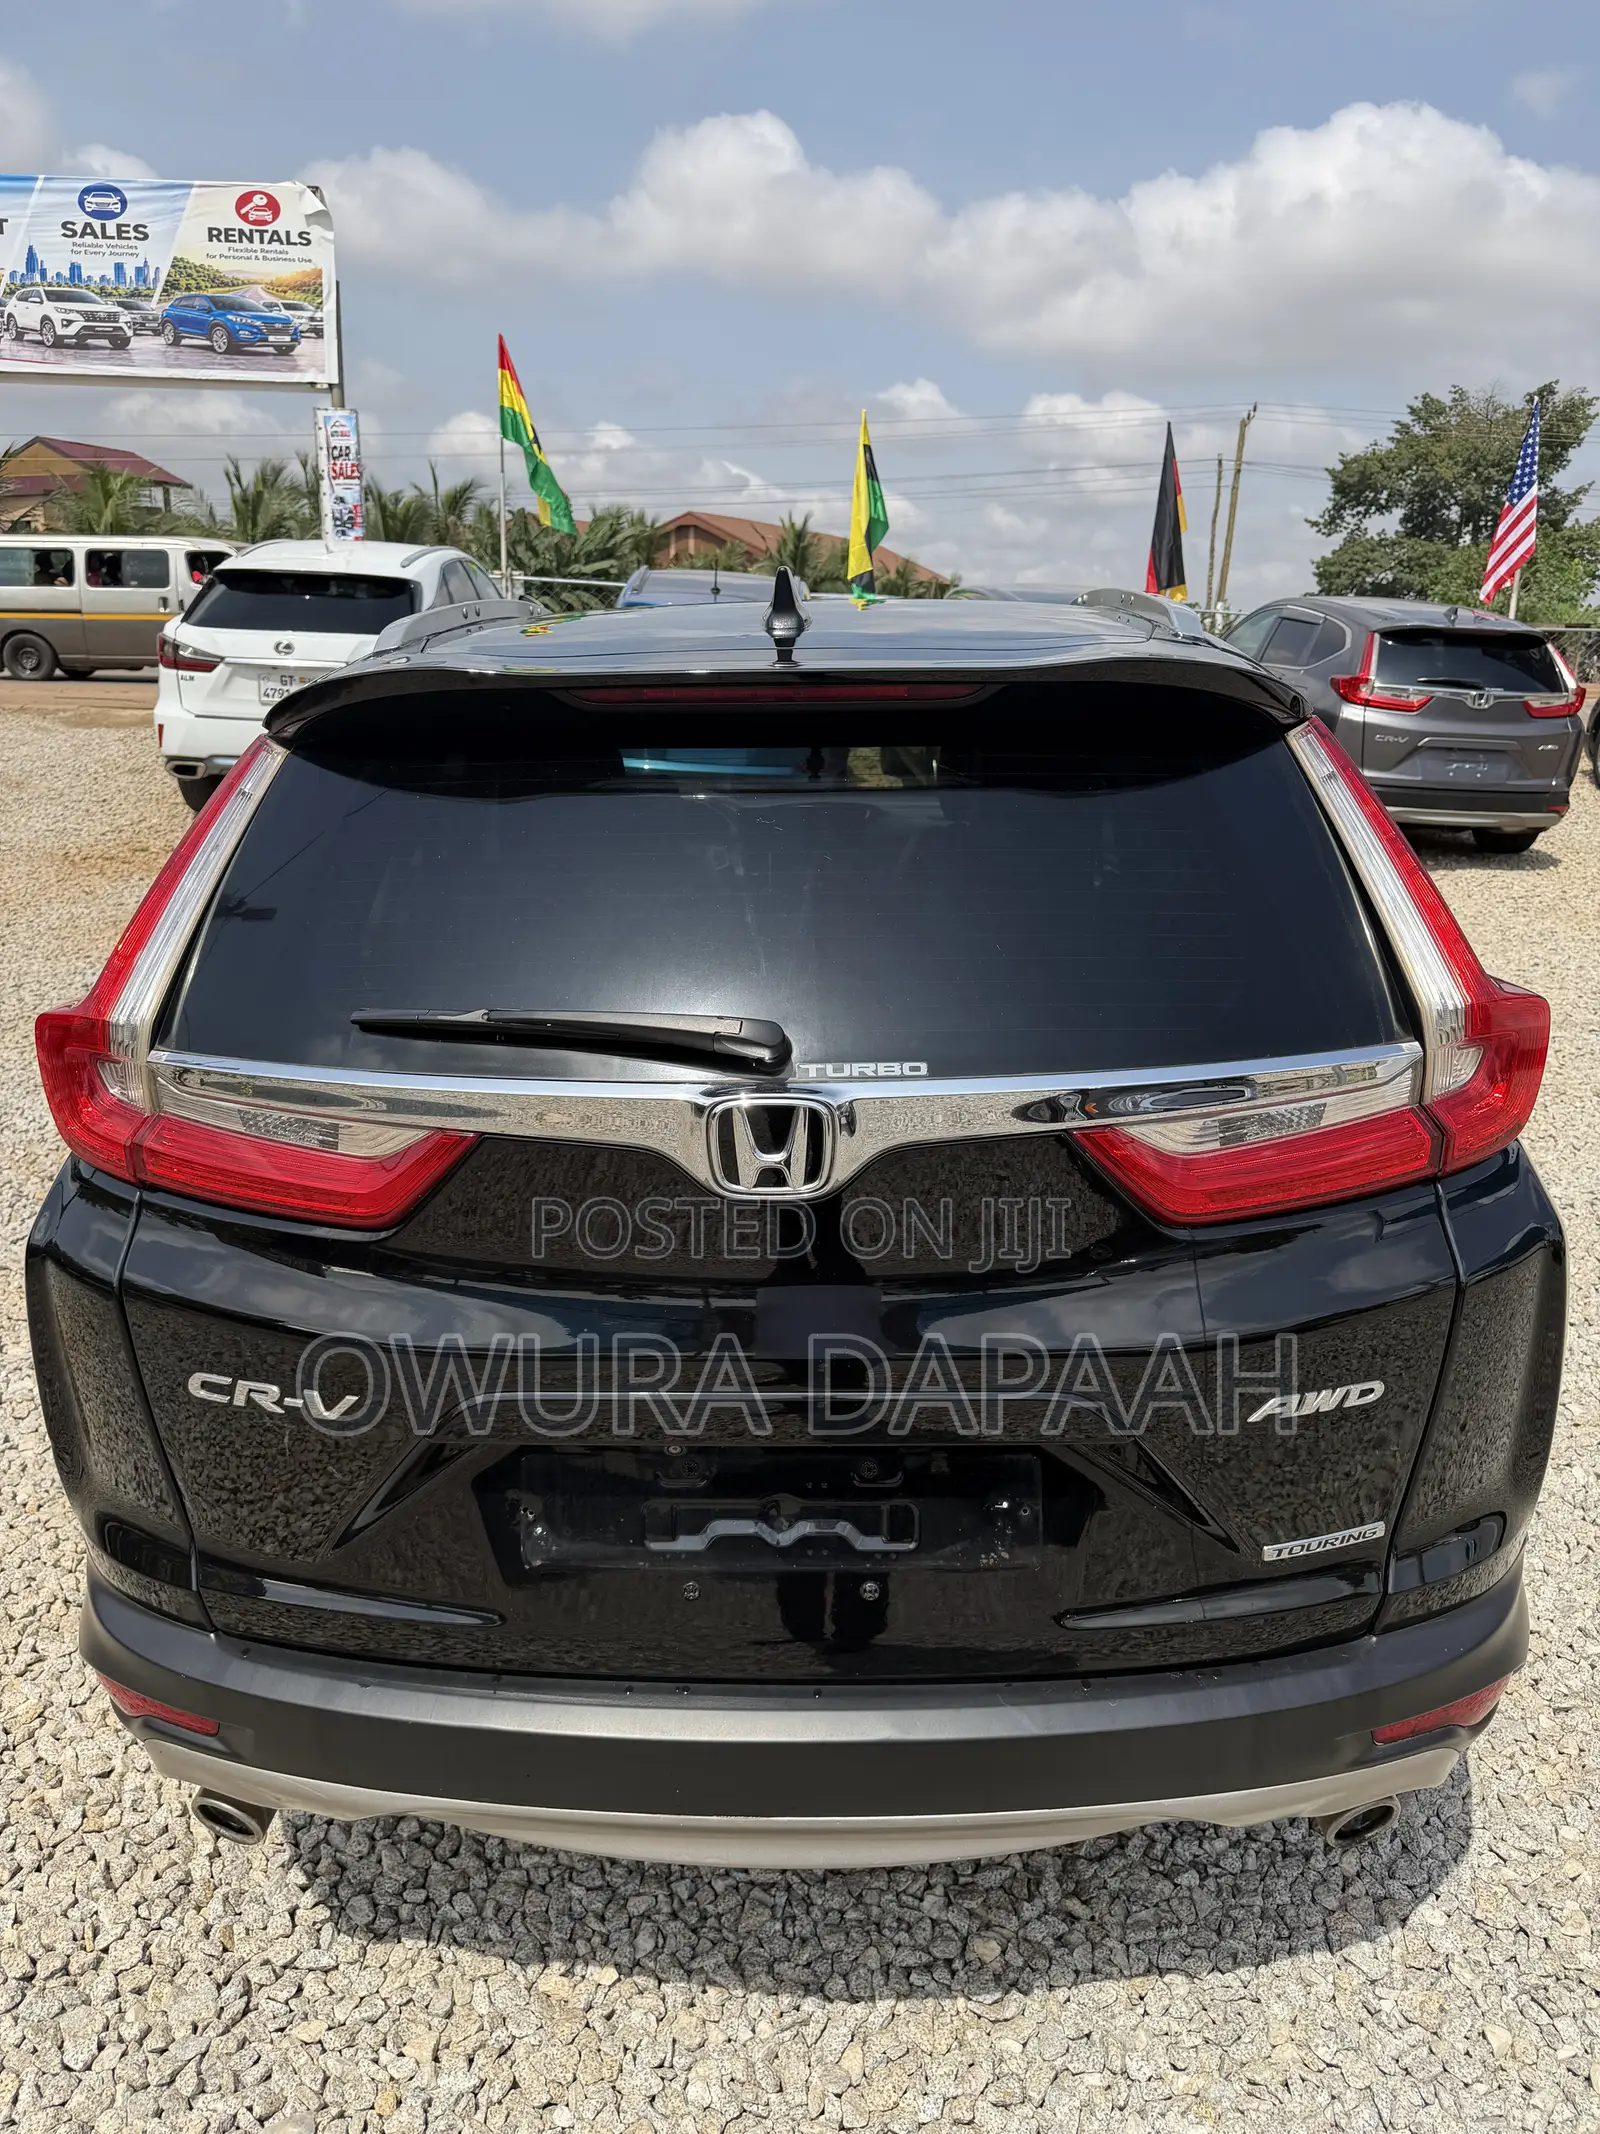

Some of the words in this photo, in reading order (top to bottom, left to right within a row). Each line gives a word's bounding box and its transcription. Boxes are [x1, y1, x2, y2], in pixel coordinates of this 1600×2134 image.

[61, 221, 149, 241] SALES
[207, 227, 311, 246] RENTALS
[72, 241, 104, 249] Reliable
[84, 249, 106, 257] Every
[262, 255, 296, 263] Business
[331, 445, 350, 459] CAR
[331, 462, 361, 480] SALES
[1374, 734, 1409, 743] CR-V
[798, 1061, 928, 1078] TURBO
[187, 1371, 360, 1421] CR-V
[1246, 1379, 1386, 1423] AWD
[1273, 1527, 1379, 1558] TOURING
